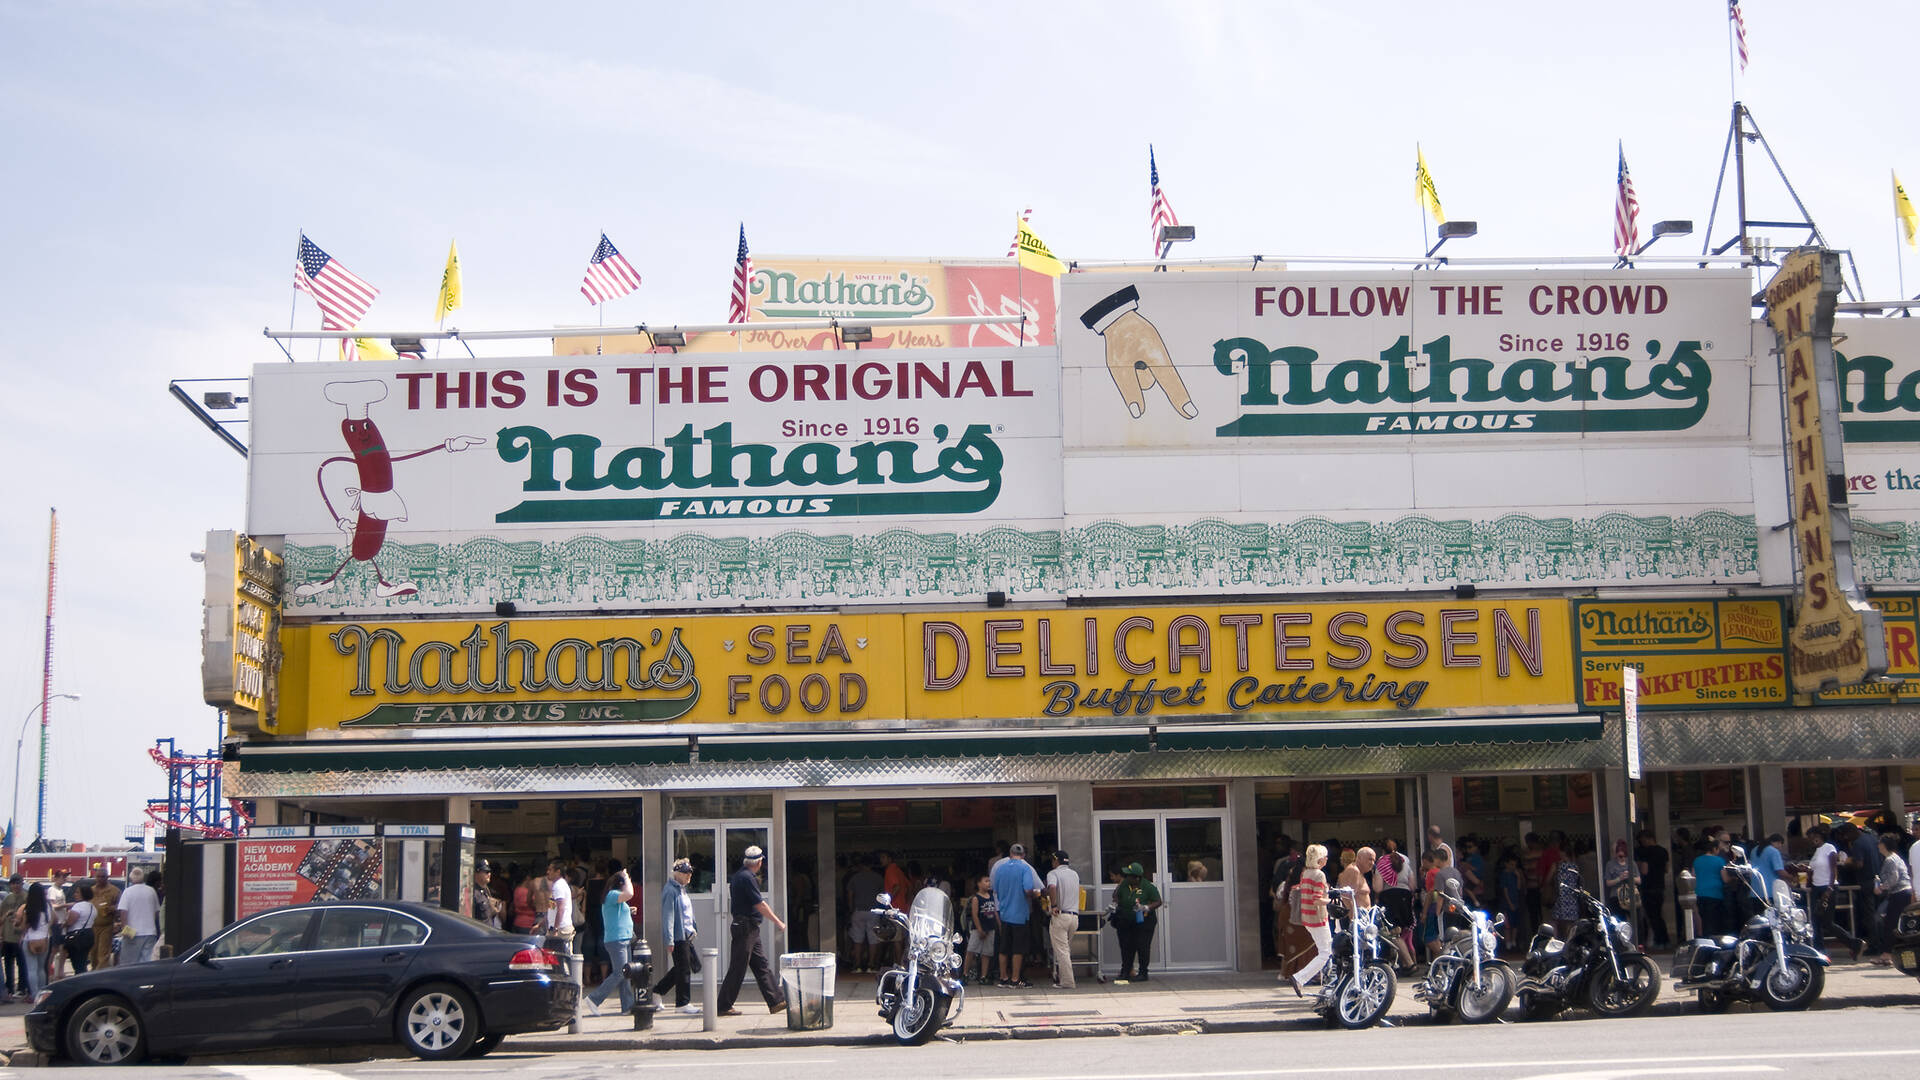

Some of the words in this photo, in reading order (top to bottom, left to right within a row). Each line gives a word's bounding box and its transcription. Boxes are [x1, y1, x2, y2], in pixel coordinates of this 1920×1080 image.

[748, 270, 935, 306] Nathan's
[1255, 286, 1410, 317] FOLLOW
[1430, 285, 1503, 316] THE
[1528, 284, 1668, 316] CROWD
[746, 329, 771, 343] For
[771, 330, 808, 349] Over
[898, 329, 945, 349] Years
[1499, 333, 1564, 352] Since
[1576, 332, 1630, 351] 1916
[1212, 334, 1712, 408] Nathan's
[396, 369, 527, 410] THIS
[547, 368, 598, 407] IS
[616, 366, 729, 405] THE
[748, 360, 1034, 403] ORIGINAL
[781, 419, 849, 437] Since
[863, 417, 920, 436] 1916
[1365, 414, 1537, 431] FAMOUS
[496, 421, 1004, 494] Nathan's
[1847, 474, 1878, 490] re
[659, 498, 834, 516] FAMOUS
[1581, 607, 1712, 636] Nathan's
[1723, 622, 1777, 642] LEMONADE
[746, 623, 852, 665] SEA
[923, 607, 1543, 692] DELICATESSEN
[328, 622, 697, 697] Nathan's
[1585, 660, 1644, 673] Serving
[1584, 655, 1784, 702] FRNKFURTERS
[727, 672, 868, 715] FOOD
[1042, 679, 1206, 717] Buffet
[1226, 672, 1430, 711] Catering
[1696, 688, 1736, 699] Since
[1742, 686, 1782, 698] 1916.
[413, 702, 570, 722] FAMOUS
[266, 827, 296, 836] TITAN
[330, 826, 360, 835] TITAN
[400, 825, 430, 834] TITAN
[244, 846, 266, 854] NEW
[270, 845, 296, 853] YORK
[244, 854, 268, 862] FILM
[244, 863, 294, 872] ACADEMY
